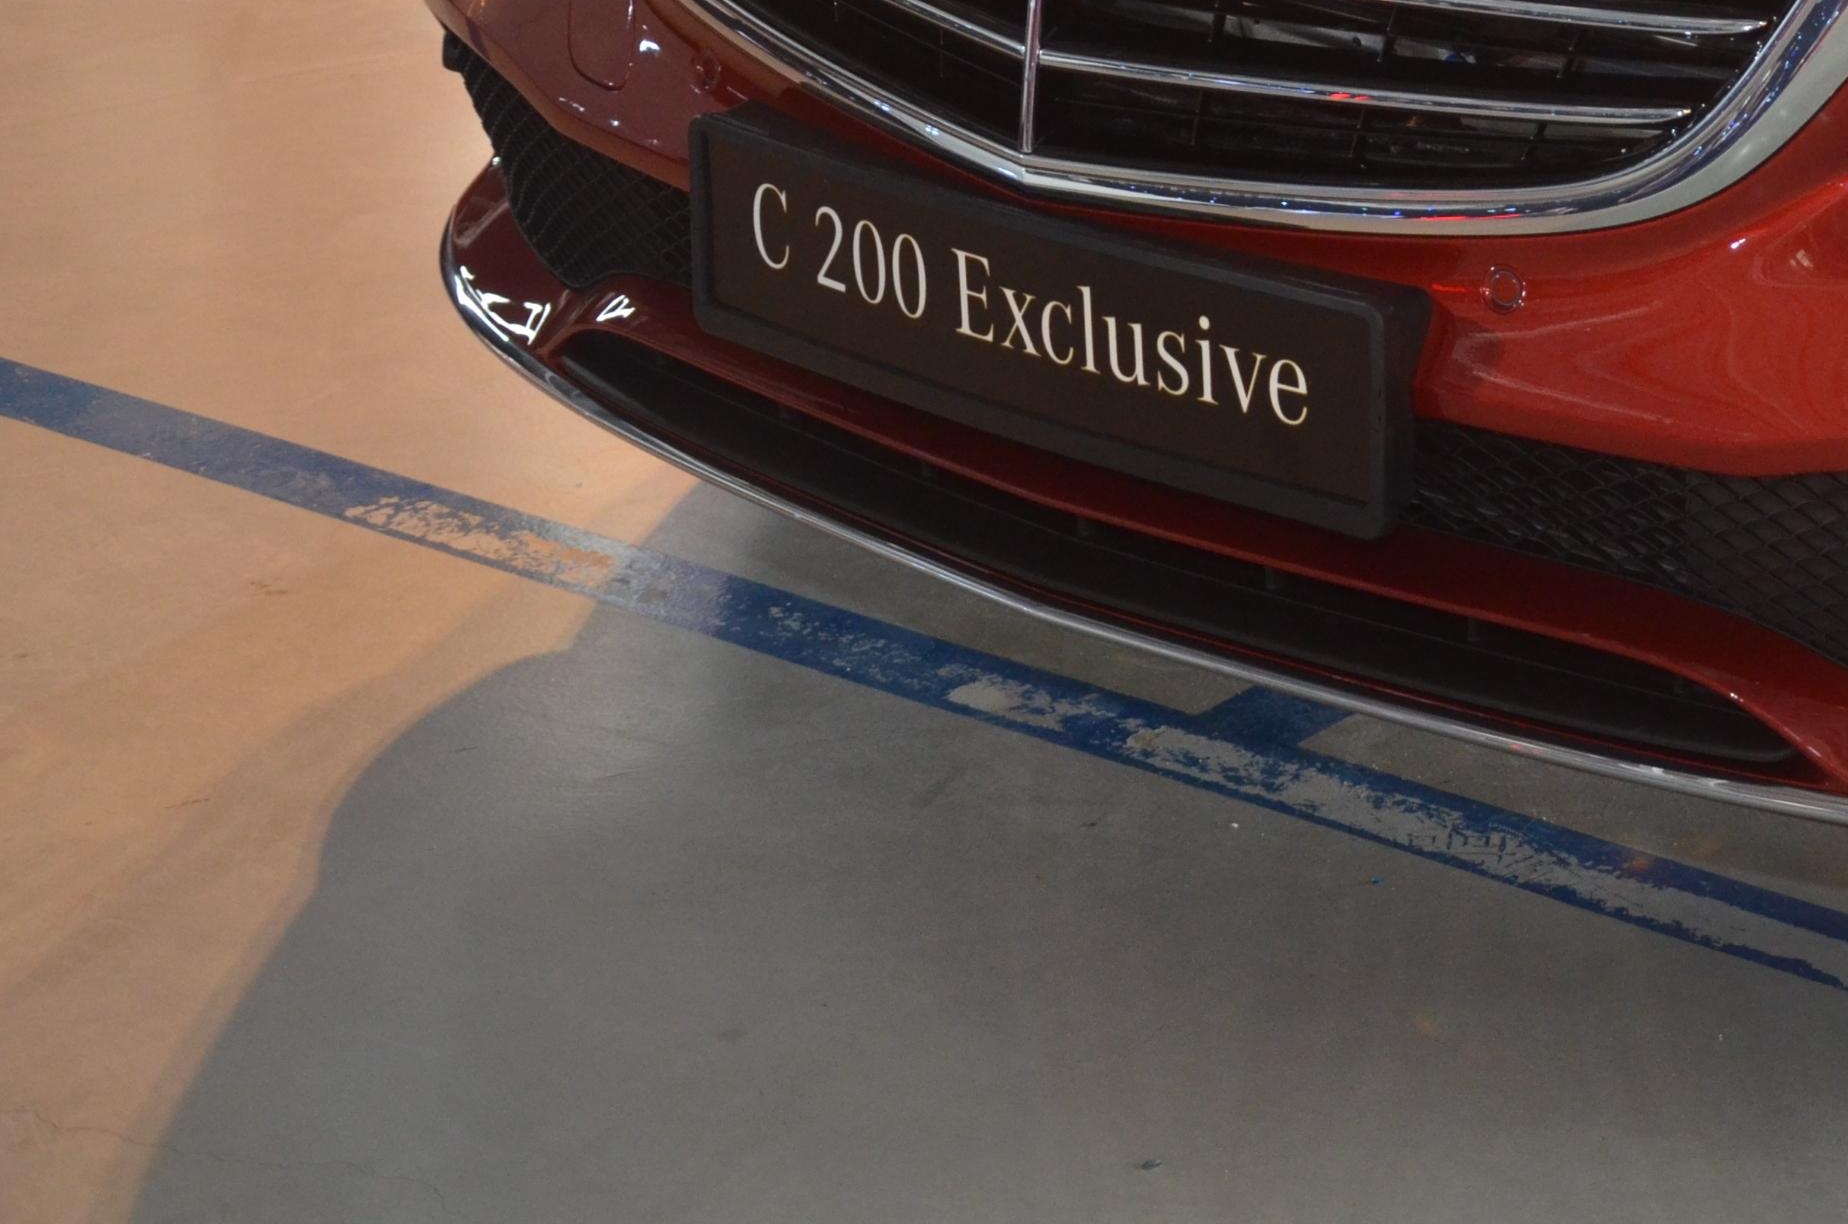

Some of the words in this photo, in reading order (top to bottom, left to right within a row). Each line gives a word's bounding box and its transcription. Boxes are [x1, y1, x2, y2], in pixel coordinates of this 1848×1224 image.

[751, 182, 791, 271] C
[814, 205, 928, 319] 200
[950, 247, 1310, 426] Exclusive
